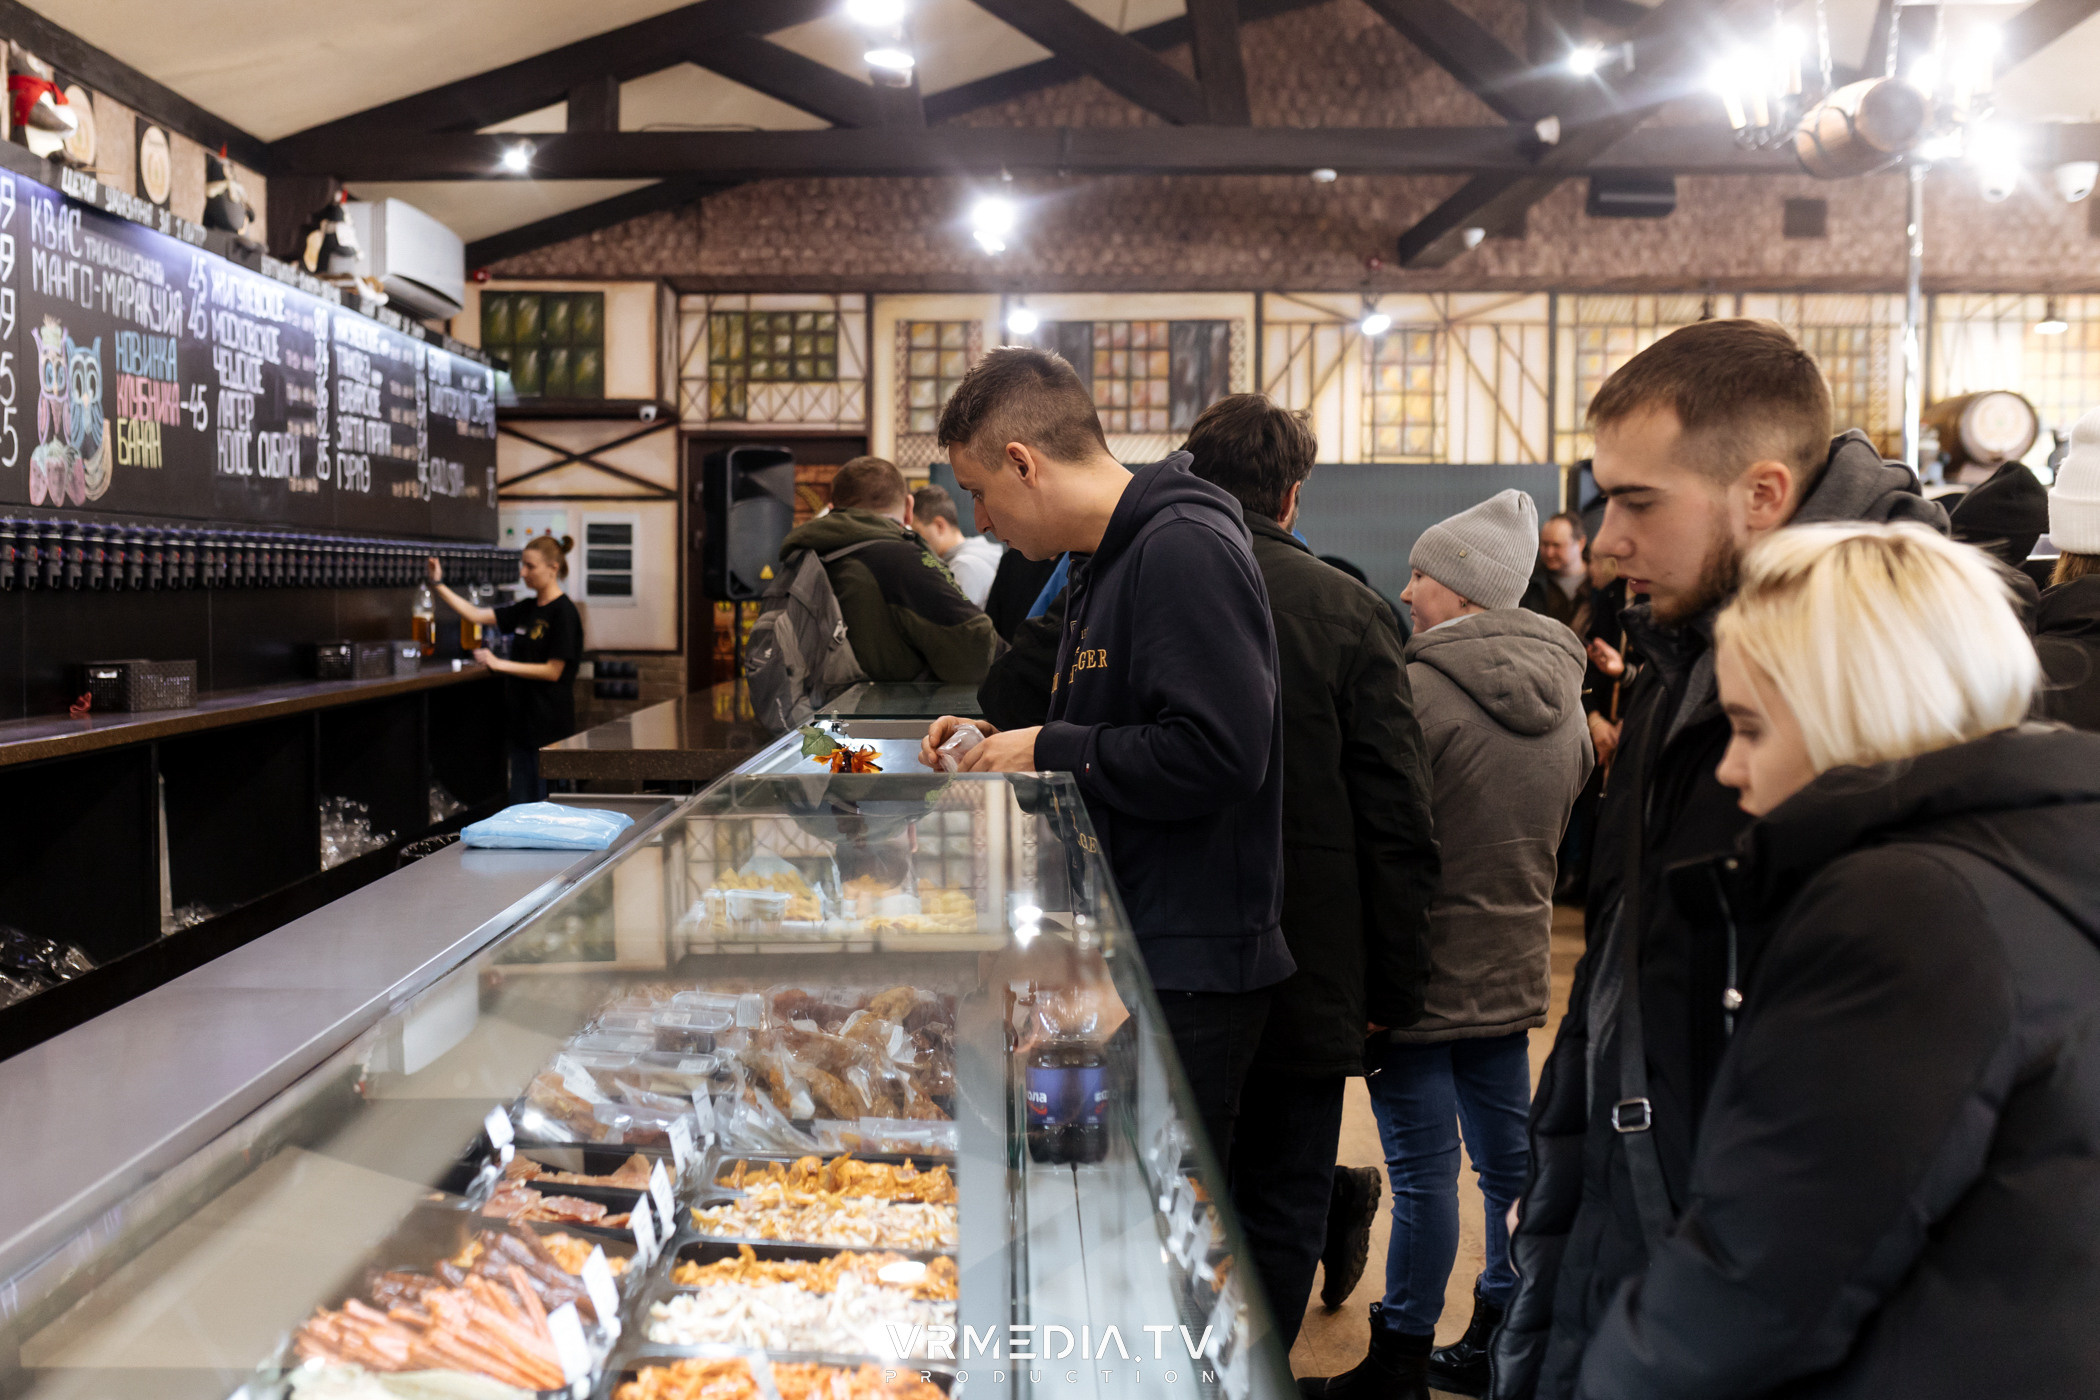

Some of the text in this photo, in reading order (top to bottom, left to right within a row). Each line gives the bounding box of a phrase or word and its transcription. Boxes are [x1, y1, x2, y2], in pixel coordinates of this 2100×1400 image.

[61, 166, 97, 203] ЦЕНА
[30, 196, 82, 258] КВАС
[31, 246, 183, 338] МАНГО-МАРАКУЙЯ
[115, 331, 178, 382] НОВИНКА
[211, 308, 281, 365] МОСКОВСКОЕ
[213, 344, 265, 395] ЧЕШСКОЕ
[116, 373, 180, 427] КЛУБНИКА
[217, 388, 255, 431] ЛАГЕР
[117, 417, 163, 469] БАНАН
[217, 428, 253, 476] КОЛОС
[258, 430, 301, 478] СИБИРИ
